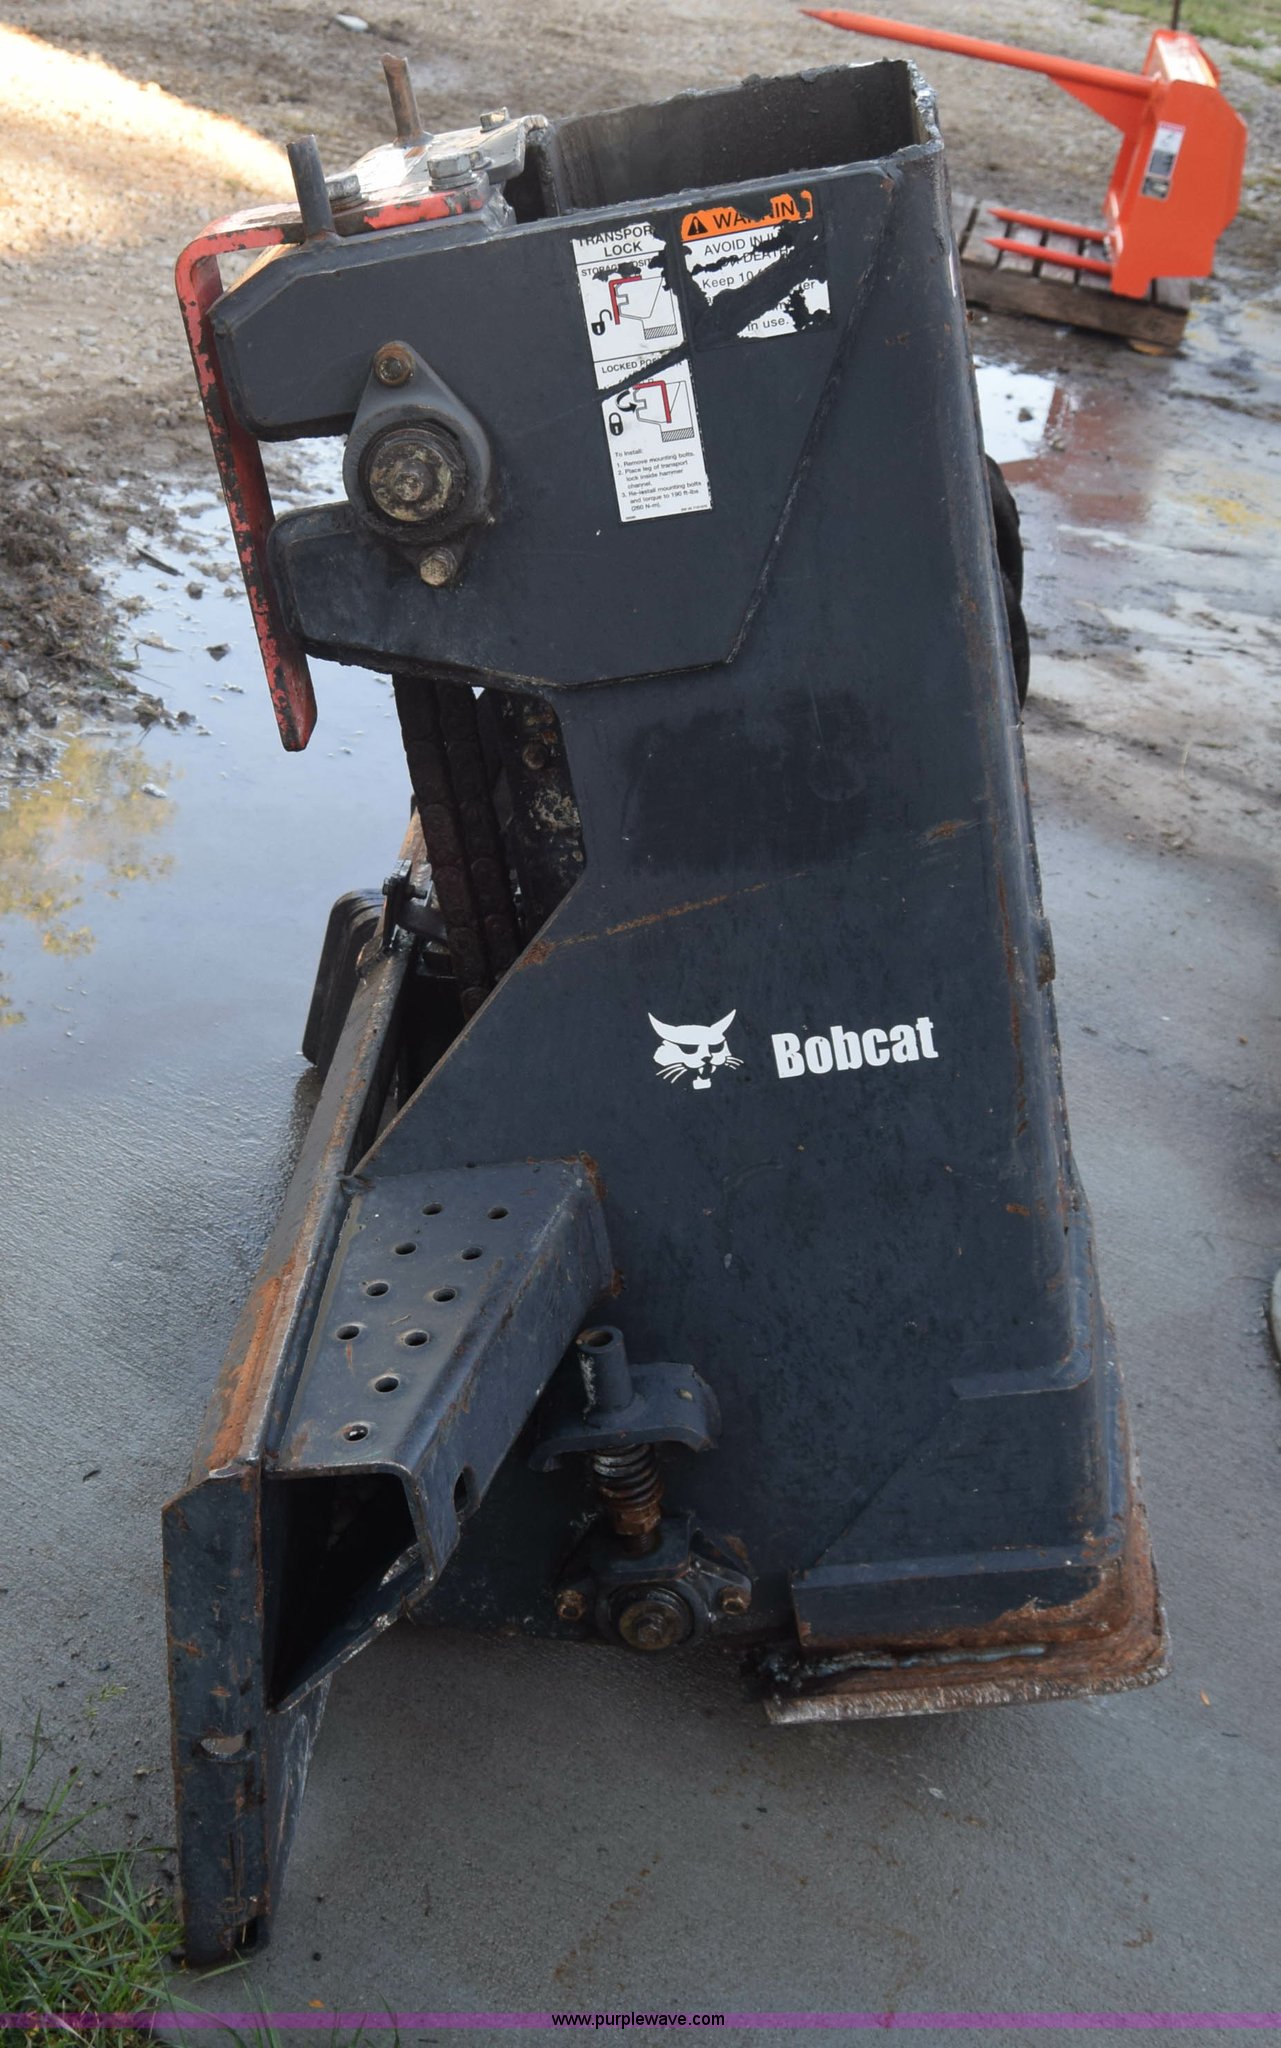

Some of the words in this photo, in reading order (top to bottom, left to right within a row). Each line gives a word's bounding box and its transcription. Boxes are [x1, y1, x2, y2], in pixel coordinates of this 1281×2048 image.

[604, 241, 643, 257] LOCK
[704, 238, 746, 256] AVOID
[702, 275, 735, 289] Keep
[739, 270, 754, 282] 10
[762, 317, 789, 329] use.
[601, 361, 638, 374] LOCKED
[649, 454, 678, 462] mounting
[660, 460, 688, 469] transport
[657, 483, 686, 492] mounting
[771, 1016, 939, 1079] Bobcat
